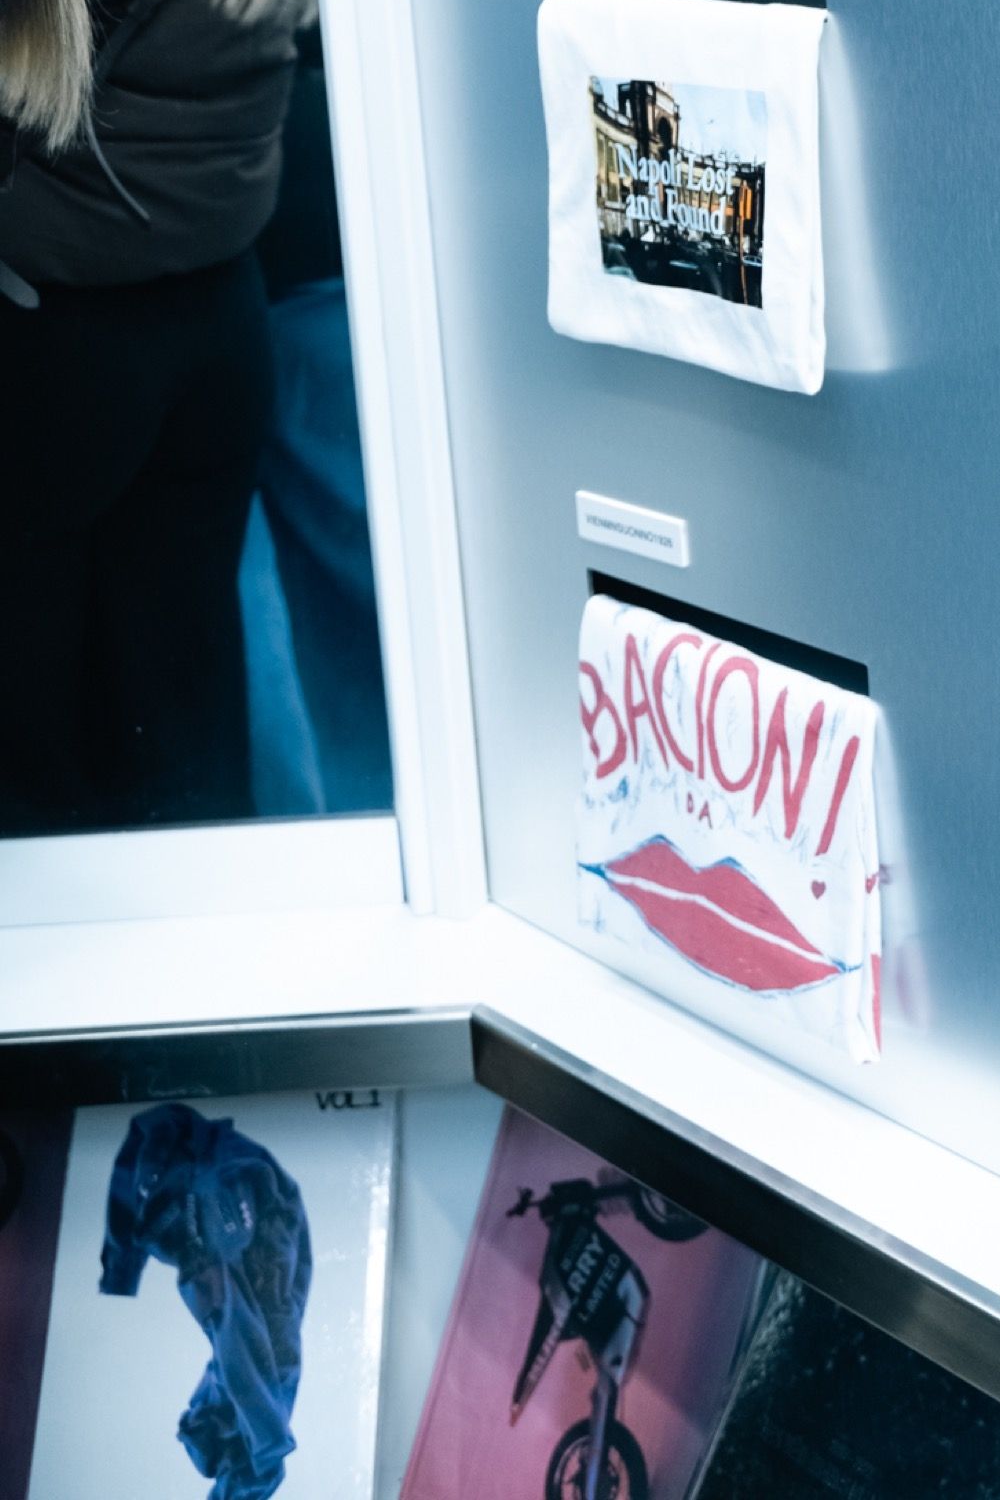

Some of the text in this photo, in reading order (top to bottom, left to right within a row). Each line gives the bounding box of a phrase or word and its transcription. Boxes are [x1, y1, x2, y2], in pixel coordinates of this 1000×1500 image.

[614, 143, 737, 195] Napoli Lost
[626, 185, 726, 236] and Found
[579, 632, 860, 856] BACIONI
